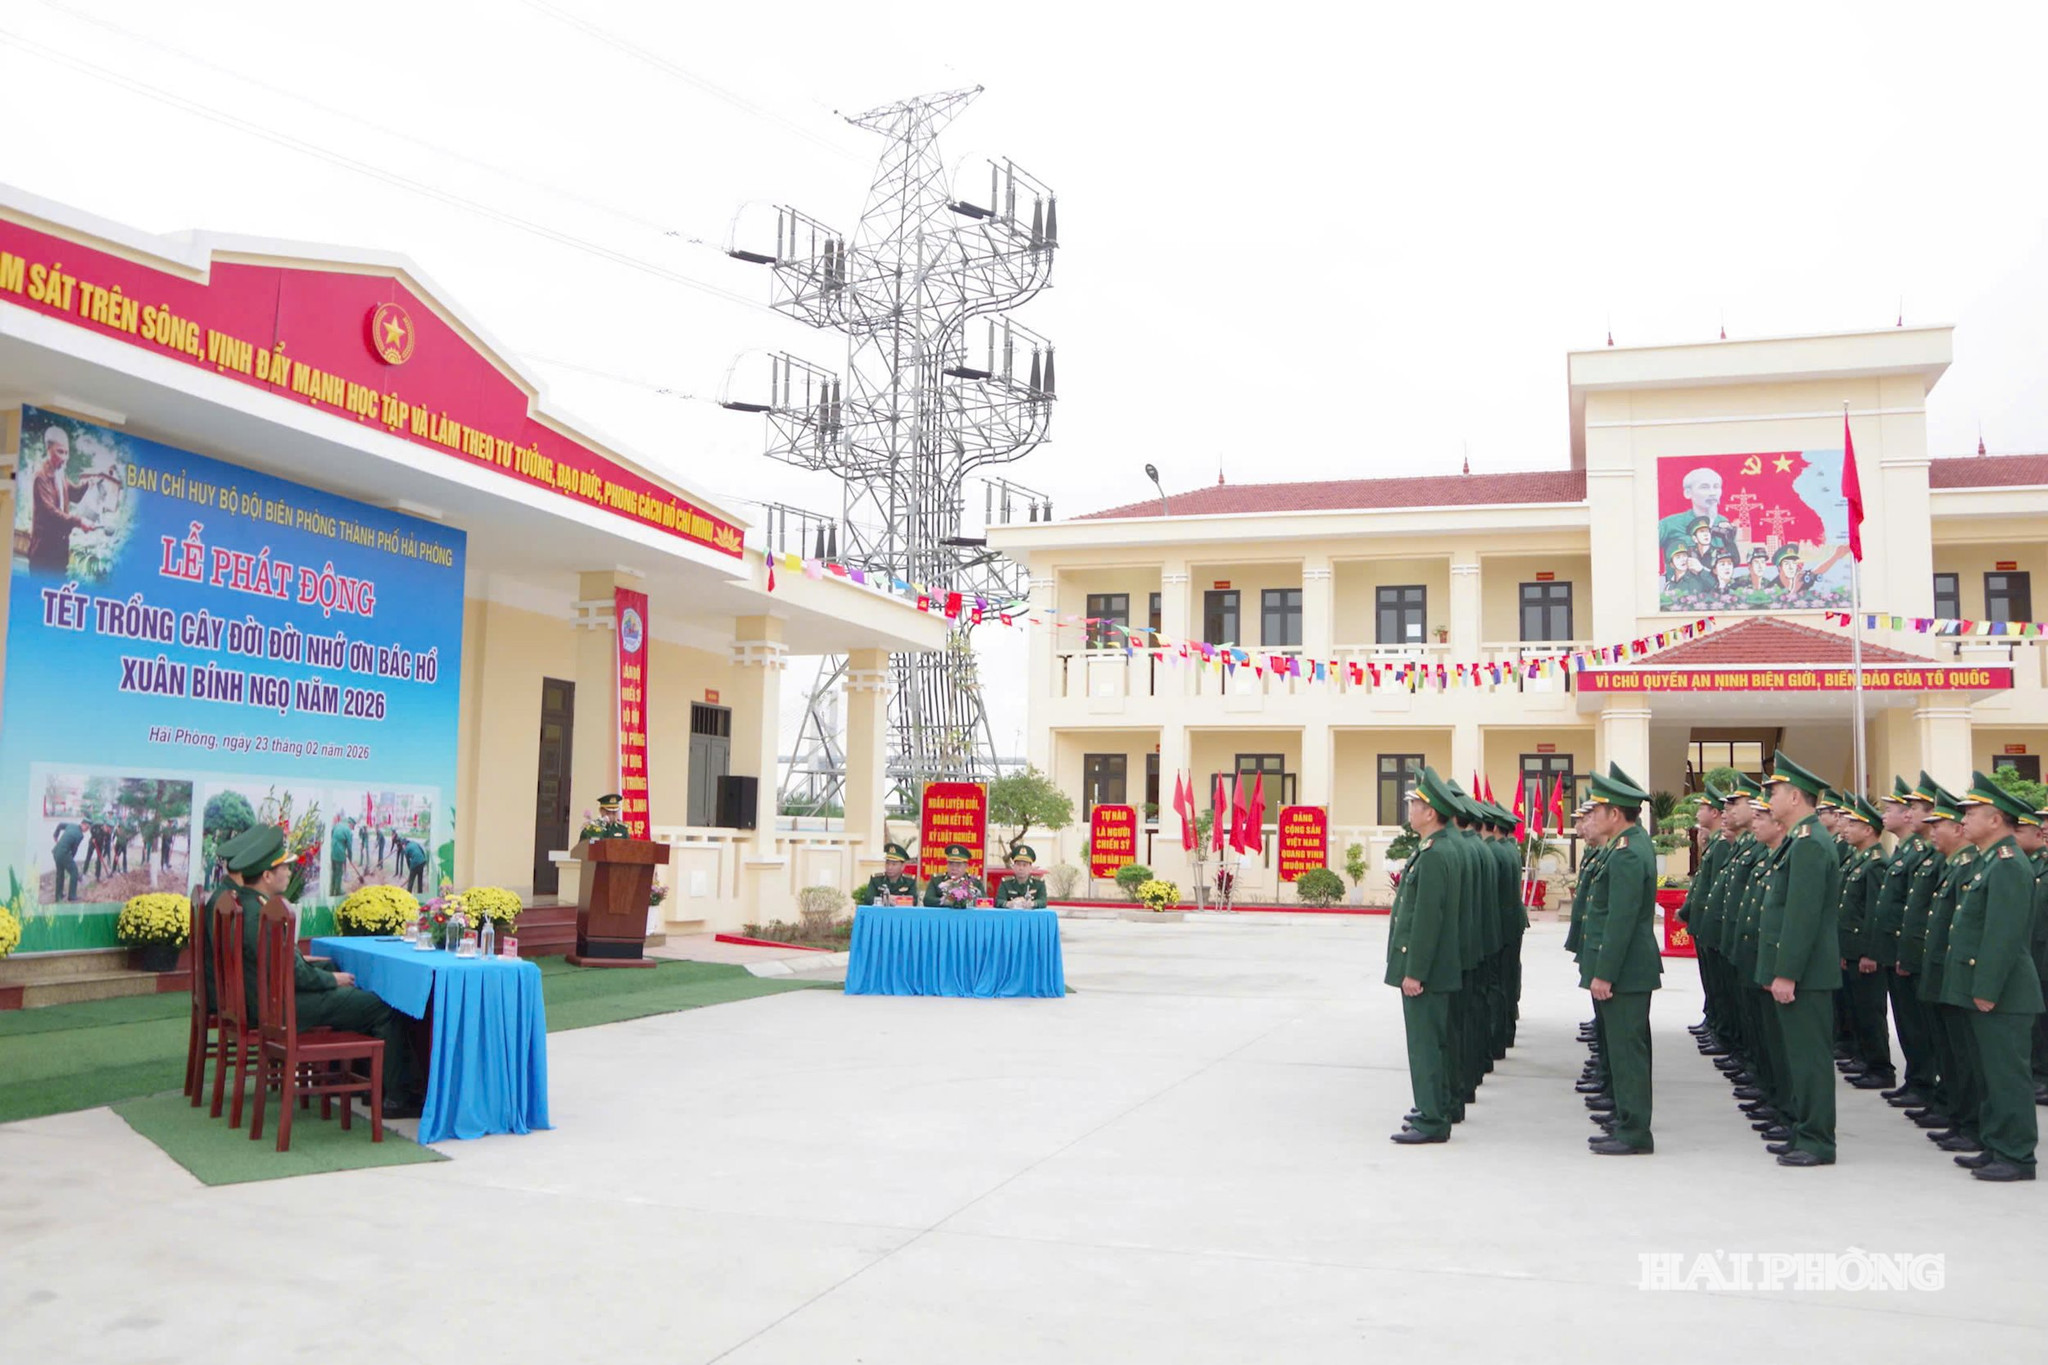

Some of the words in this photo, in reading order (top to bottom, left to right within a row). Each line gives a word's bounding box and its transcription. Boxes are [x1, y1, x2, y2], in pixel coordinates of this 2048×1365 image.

[27, 262, 77, 312] SÁT
[79, 284, 139, 335] TRÊN
[140, 303, 204, 362] SÔNG,
[207, 328, 253, 372] VỊNH
[255, 341, 291, 388] ĐẨY
[292, 361, 345, 406] MẠNH
[345, 381, 379, 422] HỌC
[380, 391, 409, 432] TẬP
[410, 403, 429, 438] VÀ
[428, 411, 461, 450] LÀM
[461, 425, 496, 462] THEO
[495, 438, 514, 468] TƯ
[514, 442, 556, 489] TƯỞNG,
[556, 463, 579, 495] ĐẠO
[579, 469, 604, 505] ĐỨC,
[603, 480, 638, 517] PHONG
[637, 491, 663, 525] CÁCH
[662, 497, 677, 529] HỒ
[675, 508, 692, 536] CHÍ
[691, 514, 716, 543] MINH
[127, 464, 157, 492] BAN
[161, 469, 186, 499] CHỈ
[188, 480, 216, 506] HUY
[219, 486, 238, 516] BỘ
[241, 492, 262, 521] ĐỘI
[265, 499, 293, 526] BIÊN
[296, 509, 336, 538] PHÒNG
[339, 520, 375, 547] THÀNH
[377, 528, 399, 554] PHỐ
[401, 532, 418, 558] HẢI
[419, 541, 453, 567] PHÒNG
[160, 521, 204, 582] LỄ
[210, 546, 292, 599] PHÁT
[297, 561, 375, 617] ĐỘNG
[43, 581, 89, 630] TẾT
[94, 592, 175, 644] TRỒNG
[180, 609, 225, 650] CÂY
[229, 616, 264, 656] ĐỜI
[269, 622, 301, 662] ĐỜI
[306, 632, 347, 669] NHỚ
[349, 642, 375, 673] ƠN
[378, 643, 412, 679] BÁC
[415, 647, 438, 683] HỒ
[1595, 672, 1609, 688] VÌ
[1612, 671, 1639, 688] CHỦ
[1642, 671, 1688, 690] QUYỀN
[1691, 674, 1711, 688] AN
[1714, 673, 1749, 688] NINH
[1751, 670, 1784, 688] BIÊN
[1788, 670, 1820, 688] GIỚI,
[1893, 670, 1923, 687] CỦA
[1925, 669, 1946, 686] TỔ
[1949, 668, 1990, 687] QUỐC
[119, 654, 186, 697] XUÂN
[191, 661, 244, 704] BÍNH
[249, 674, 290, 715] NGỌ
[295, 677, 339, 714] NĂM
[343, 688, 385, 720] 2026
[149, 726, 172, 743] Hải
[174, 728, 218, 750] Phòng,
[222, 734, 252, 753] ngày
[255, 736, 269, 751] 23
[272, 738, 302, 757] tháng
[306, 741, 318, 755] 02
[321, 744, 343, 757] năm
[346, 745, 370, 761] 2026
[949, 812, 962, 826] KẾT
[1101, 810, 1111, 822] TỰ
[1111, 809, 1128, 821] HÀO
[1293, 811, 1313, 823] ĐẢNG
[1096, 825, 1106, 837] LÀ
[1107, 826, 1131, 837] NGƯỜI
[1285, 824, 1305, 836] CỘNG
[1305, 823, 1321, 834] SẢN
[1096, 838, 1119, 850] CHIẾN
[1286, 837, 1302, 848] VIỆT
[1303, 838, 1320, 847] NAM
[1281, 850, 1305, 858] QUANG
[1306, 850, 1324, 859] VINH
[1282, 860, 1305, 870] MUÔN
